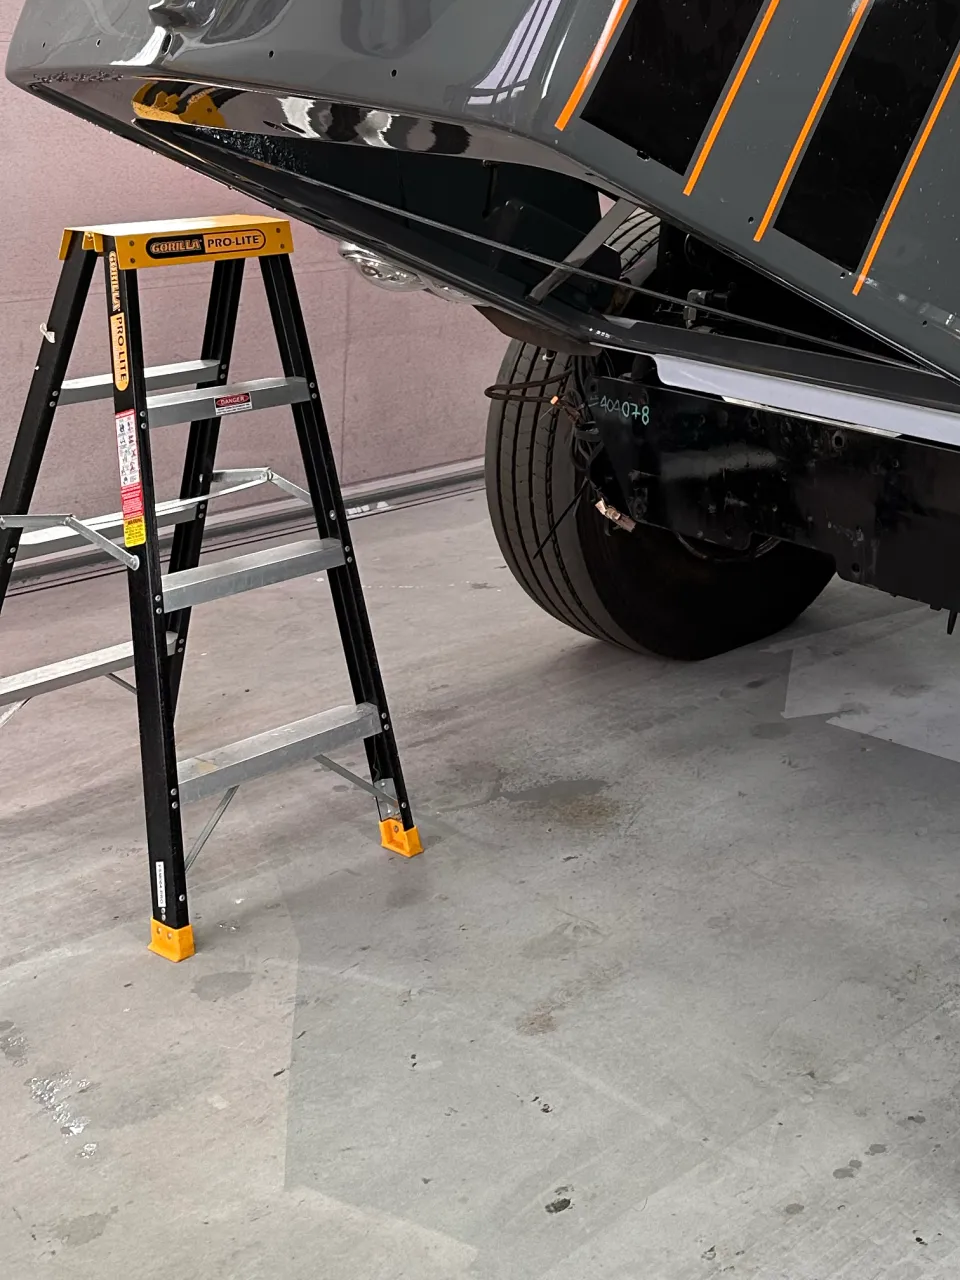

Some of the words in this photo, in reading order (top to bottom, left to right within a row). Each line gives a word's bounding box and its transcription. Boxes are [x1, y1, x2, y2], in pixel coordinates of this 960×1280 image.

[150, 239, 202, 255] GORILLA
[208, 235, 261, 249] PRO-LITE
[109, 251, 121, 312] GORILLA
[220, 396, 245, 406] DANGER
[600, 395, 650, 426] 404078
